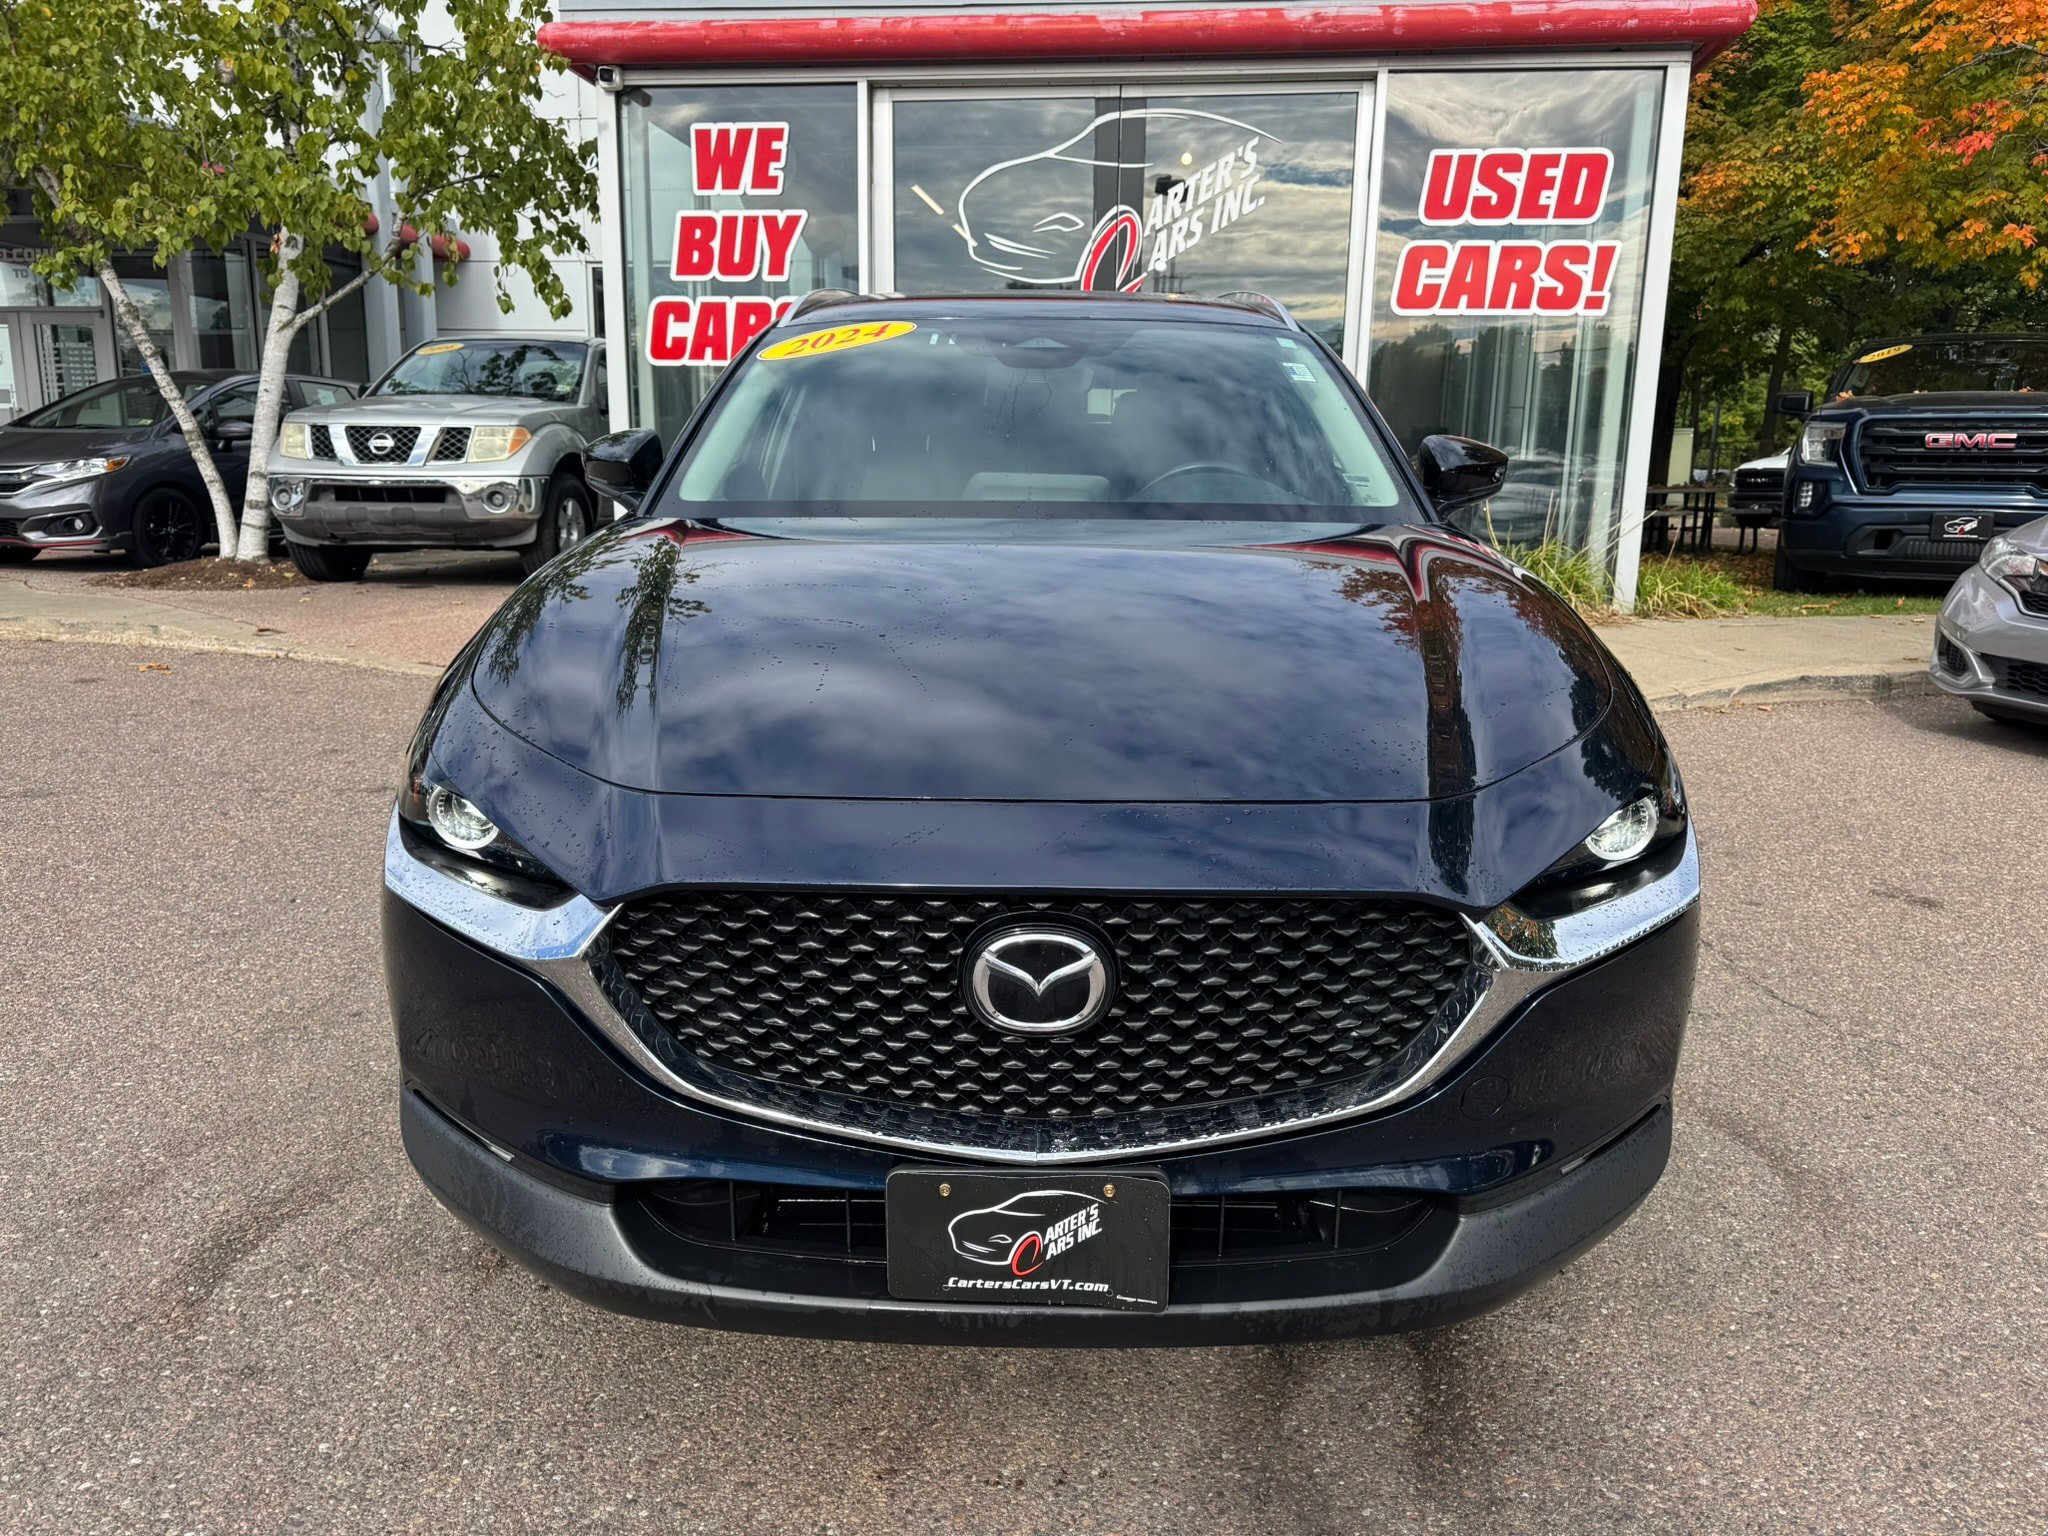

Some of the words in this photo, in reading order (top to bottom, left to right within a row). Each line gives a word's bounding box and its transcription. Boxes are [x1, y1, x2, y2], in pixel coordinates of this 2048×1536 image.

[691, 124, 788, 194] WE
[1420, 149, 1612, 223] USED
[1210, 174, 1265, 235] INC.
[672, 212, 806, 280] BUY
[1392, 241, 1620, 314] CARS!
[783, 323, 890, 356] 2024
[1925, 433, 2018, 449] GMC
[1078, 1218, 1102, 1243] INC.
[947, 1276, 1109, 1292] CartersCarsVT.com
